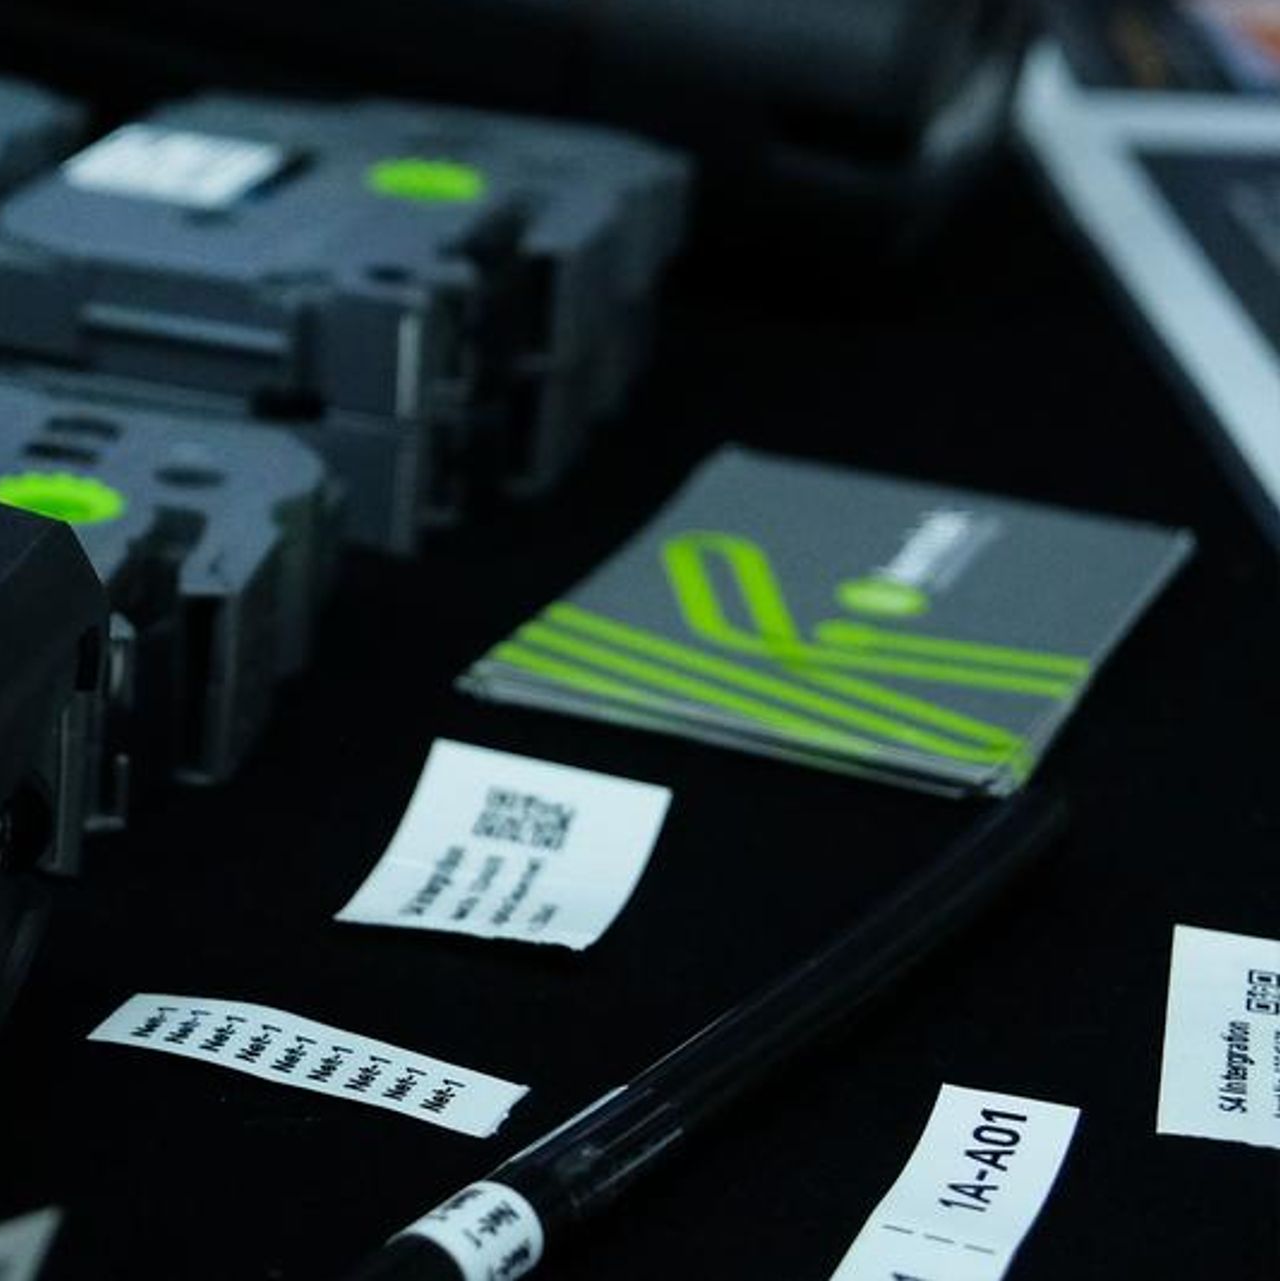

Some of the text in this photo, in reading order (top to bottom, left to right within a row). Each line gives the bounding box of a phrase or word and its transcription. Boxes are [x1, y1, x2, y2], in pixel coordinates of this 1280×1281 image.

[198, 1014, 248, 1054] Net-1
[234, 1023, 284, 1065] Net-1
[269, 1034, 318, 1075] Net-1
[305, 1044, 355, 1084] Net-1
[343, 1054, 393, 1094] Net-1
[381, 1066, 429, 1103] Net-1
[419, 1077, 467, 1115] Net-1
[938, 1107, 1029, 1213] 1A-A01
